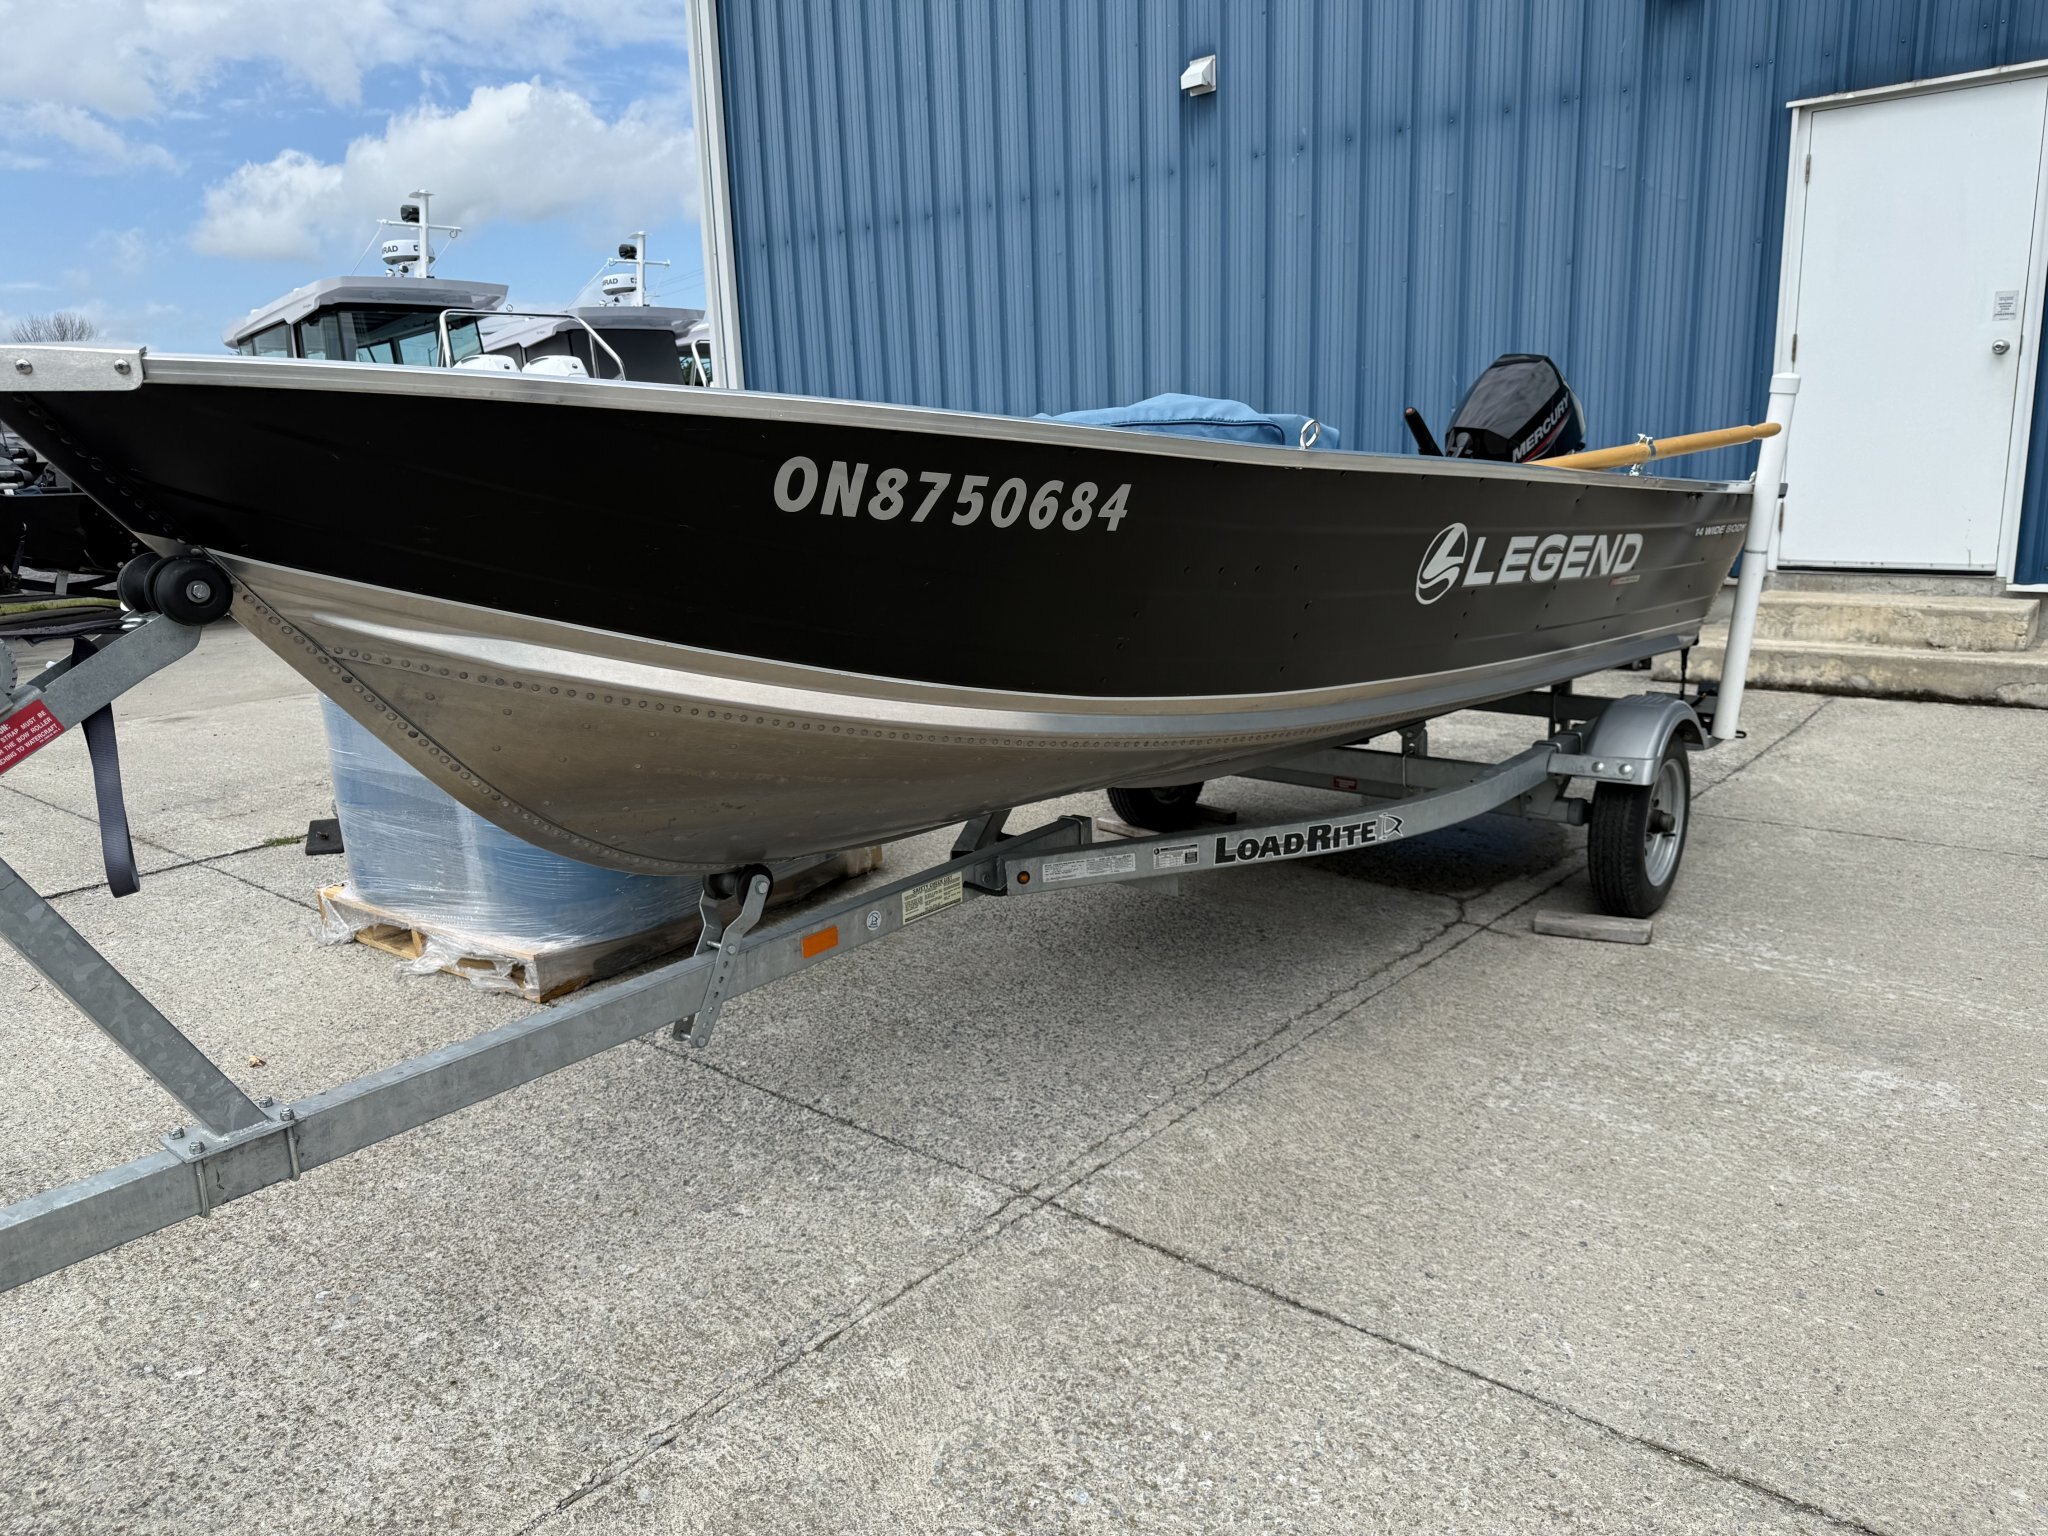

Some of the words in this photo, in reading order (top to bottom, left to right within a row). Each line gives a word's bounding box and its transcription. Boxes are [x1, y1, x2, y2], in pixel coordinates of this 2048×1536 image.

[1512, 391, 1569, 464] MERCURY
[773, 456, 1132, 531] ON8750684
[1704, 525, 1726, 536] WIDE
[1461, 533, 1643, 587] LEGEND
[0, 728, 19, 743] STRAP
[20, 716, 36, 730] MUST
[37, 710, 47, 719] BE
[4, 741, 16, 751] THE
[16, 732, 30, 743] BOW
[30, 717, 52, 733] ROLLER
[24, 723, 58, 748] WATERCRAFT
